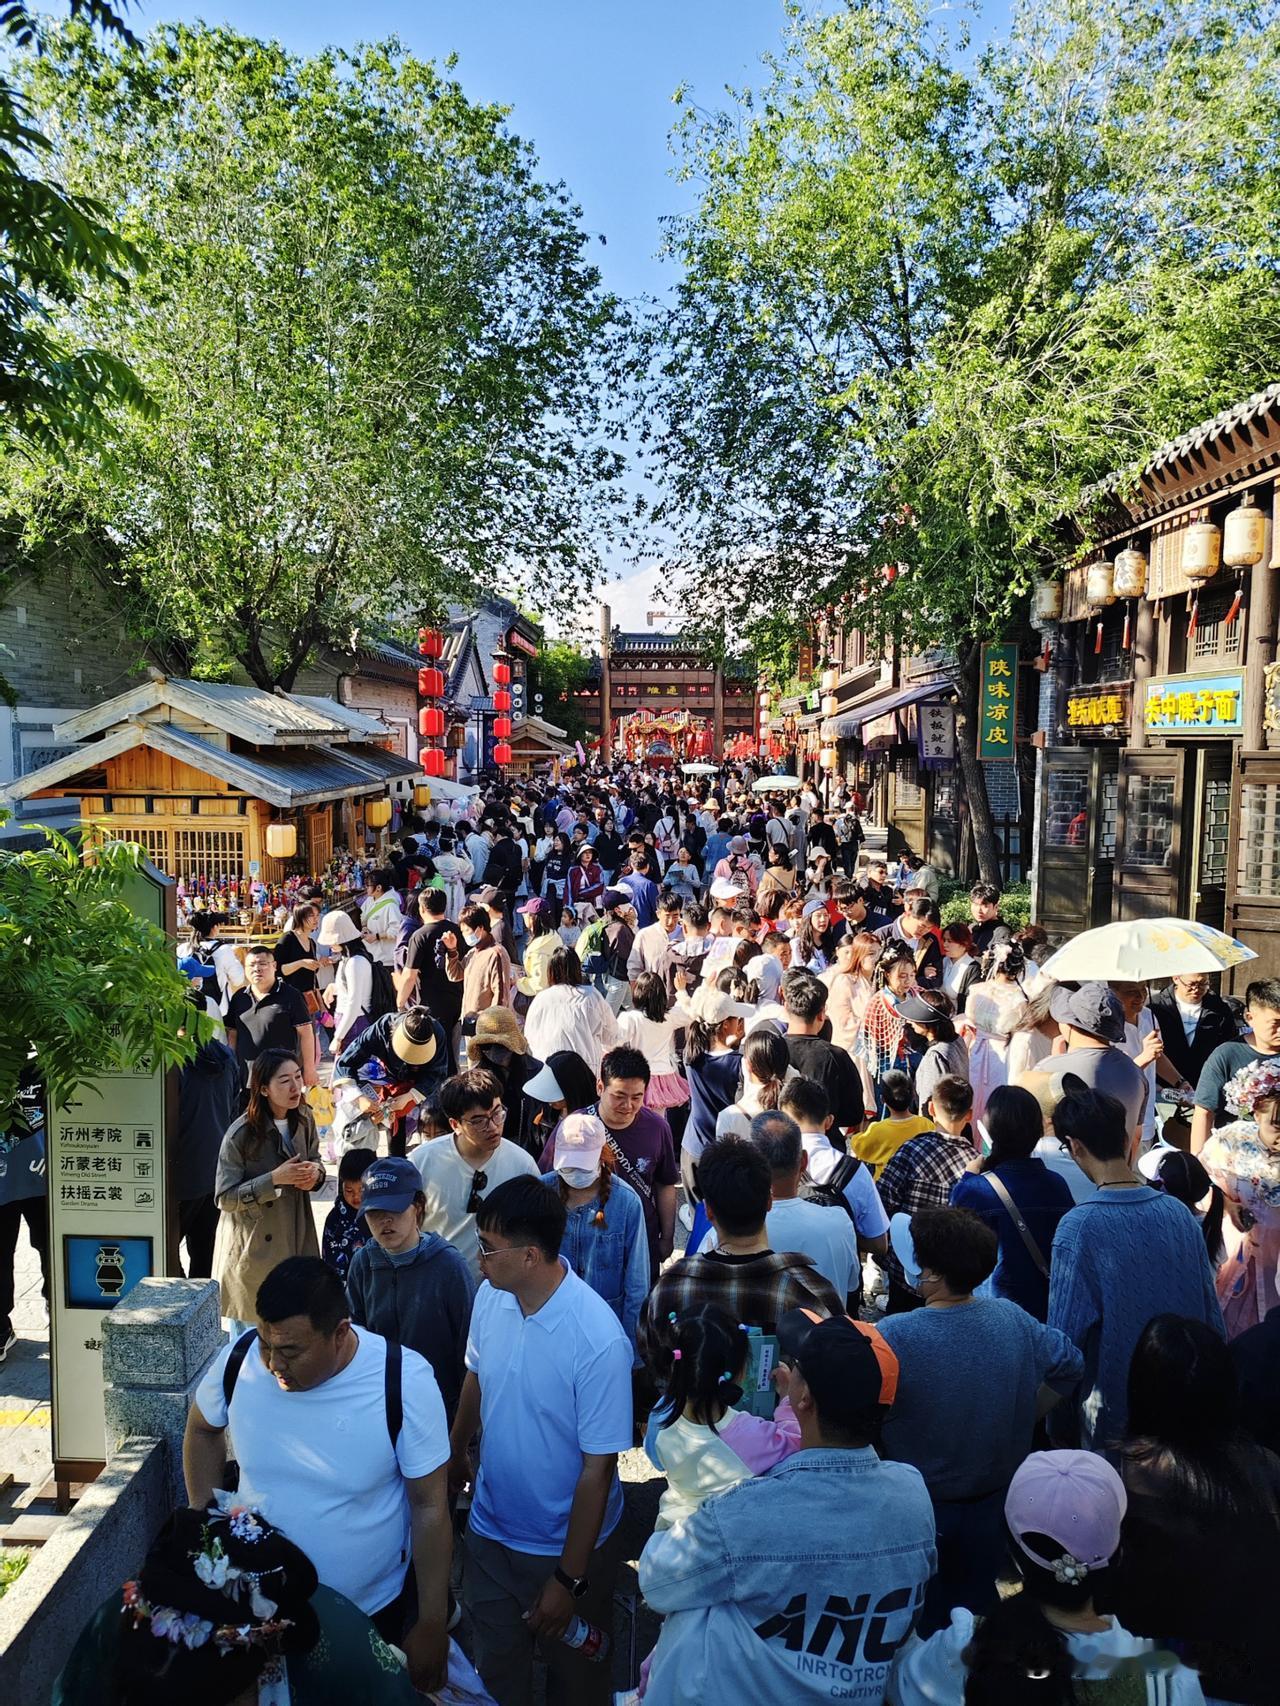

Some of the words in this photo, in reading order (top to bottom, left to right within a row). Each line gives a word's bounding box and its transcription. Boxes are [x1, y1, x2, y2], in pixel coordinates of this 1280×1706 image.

[985, 659, 1011, 744] 陕味凉皮
[60, 1127, 122, 1143] 沂州考院
[60, 1156, 122, 1172] 沂蒙老街
[61, 1185, 123, 1201] 扶摇云裳
